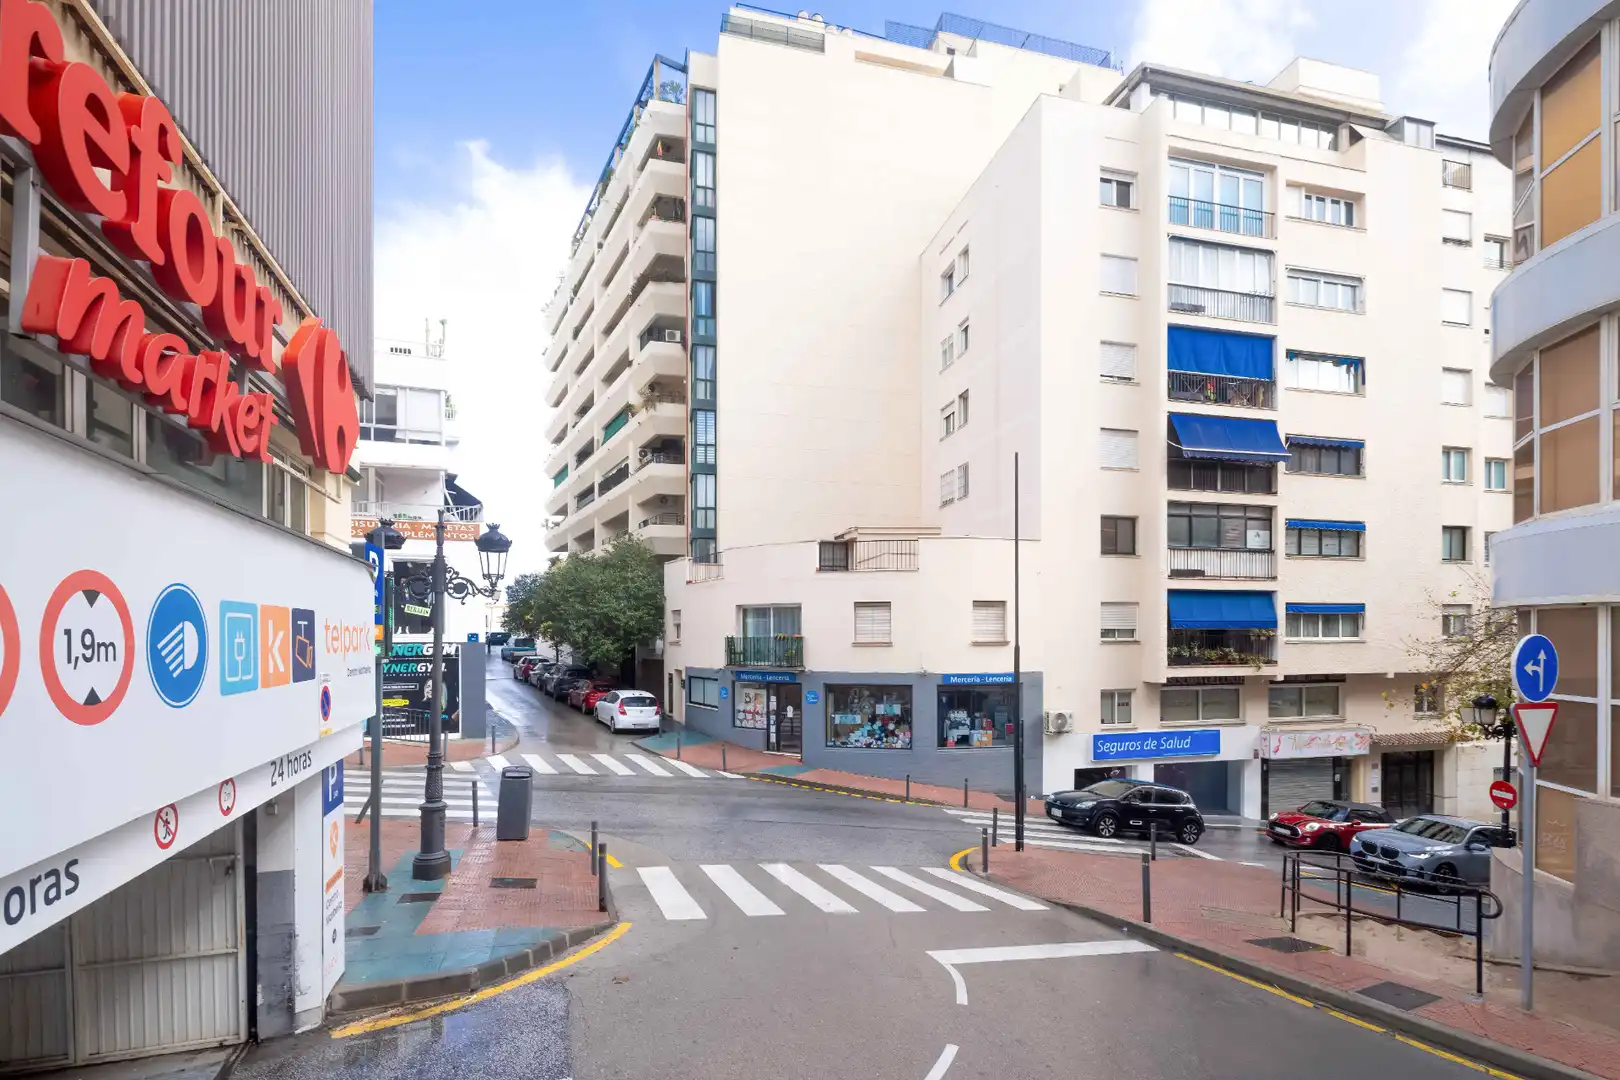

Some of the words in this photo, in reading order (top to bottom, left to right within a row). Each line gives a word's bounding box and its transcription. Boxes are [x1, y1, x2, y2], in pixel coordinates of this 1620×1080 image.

[45, 256, 278, 464] market
[421, 522, 475, 532] METAS
[63, 628, 117, 670] 1,9m
[324, 616, 371, 662] telpark
[391, 643, 457, 656] NERGM
[1097, 740, 1141, 755] Seguros
[1143, 738, 1157, 750] de
[1160, 736, 1191, 749] Salud
[270, 758, 284, 787] 24
[287, 750, 312, 779] horas
